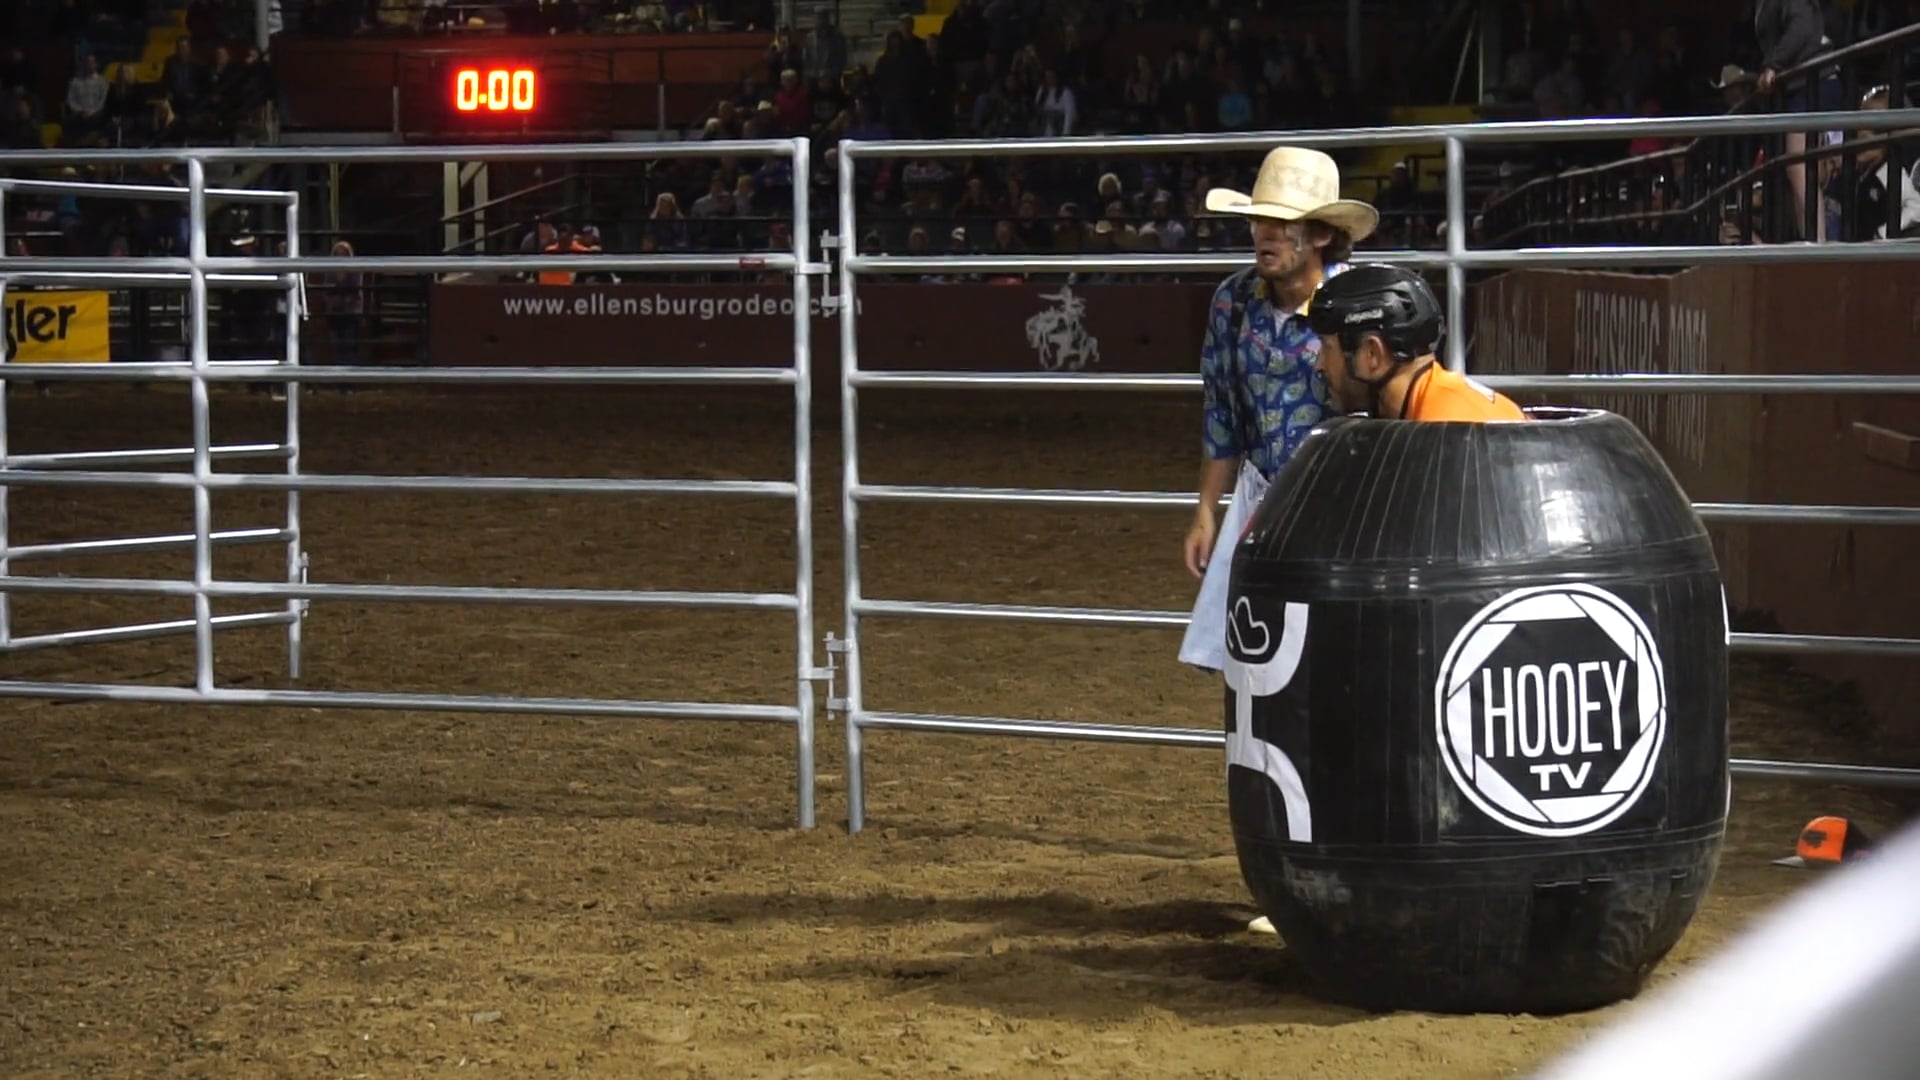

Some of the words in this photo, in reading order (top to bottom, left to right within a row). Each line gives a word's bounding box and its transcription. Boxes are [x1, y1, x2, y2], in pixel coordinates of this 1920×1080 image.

[503, 293, 863, 320] www.ellensburgrodeoc
[1481, 659, 1627, 758] HOOEY
[1529, 762, 1592, 791] TV
